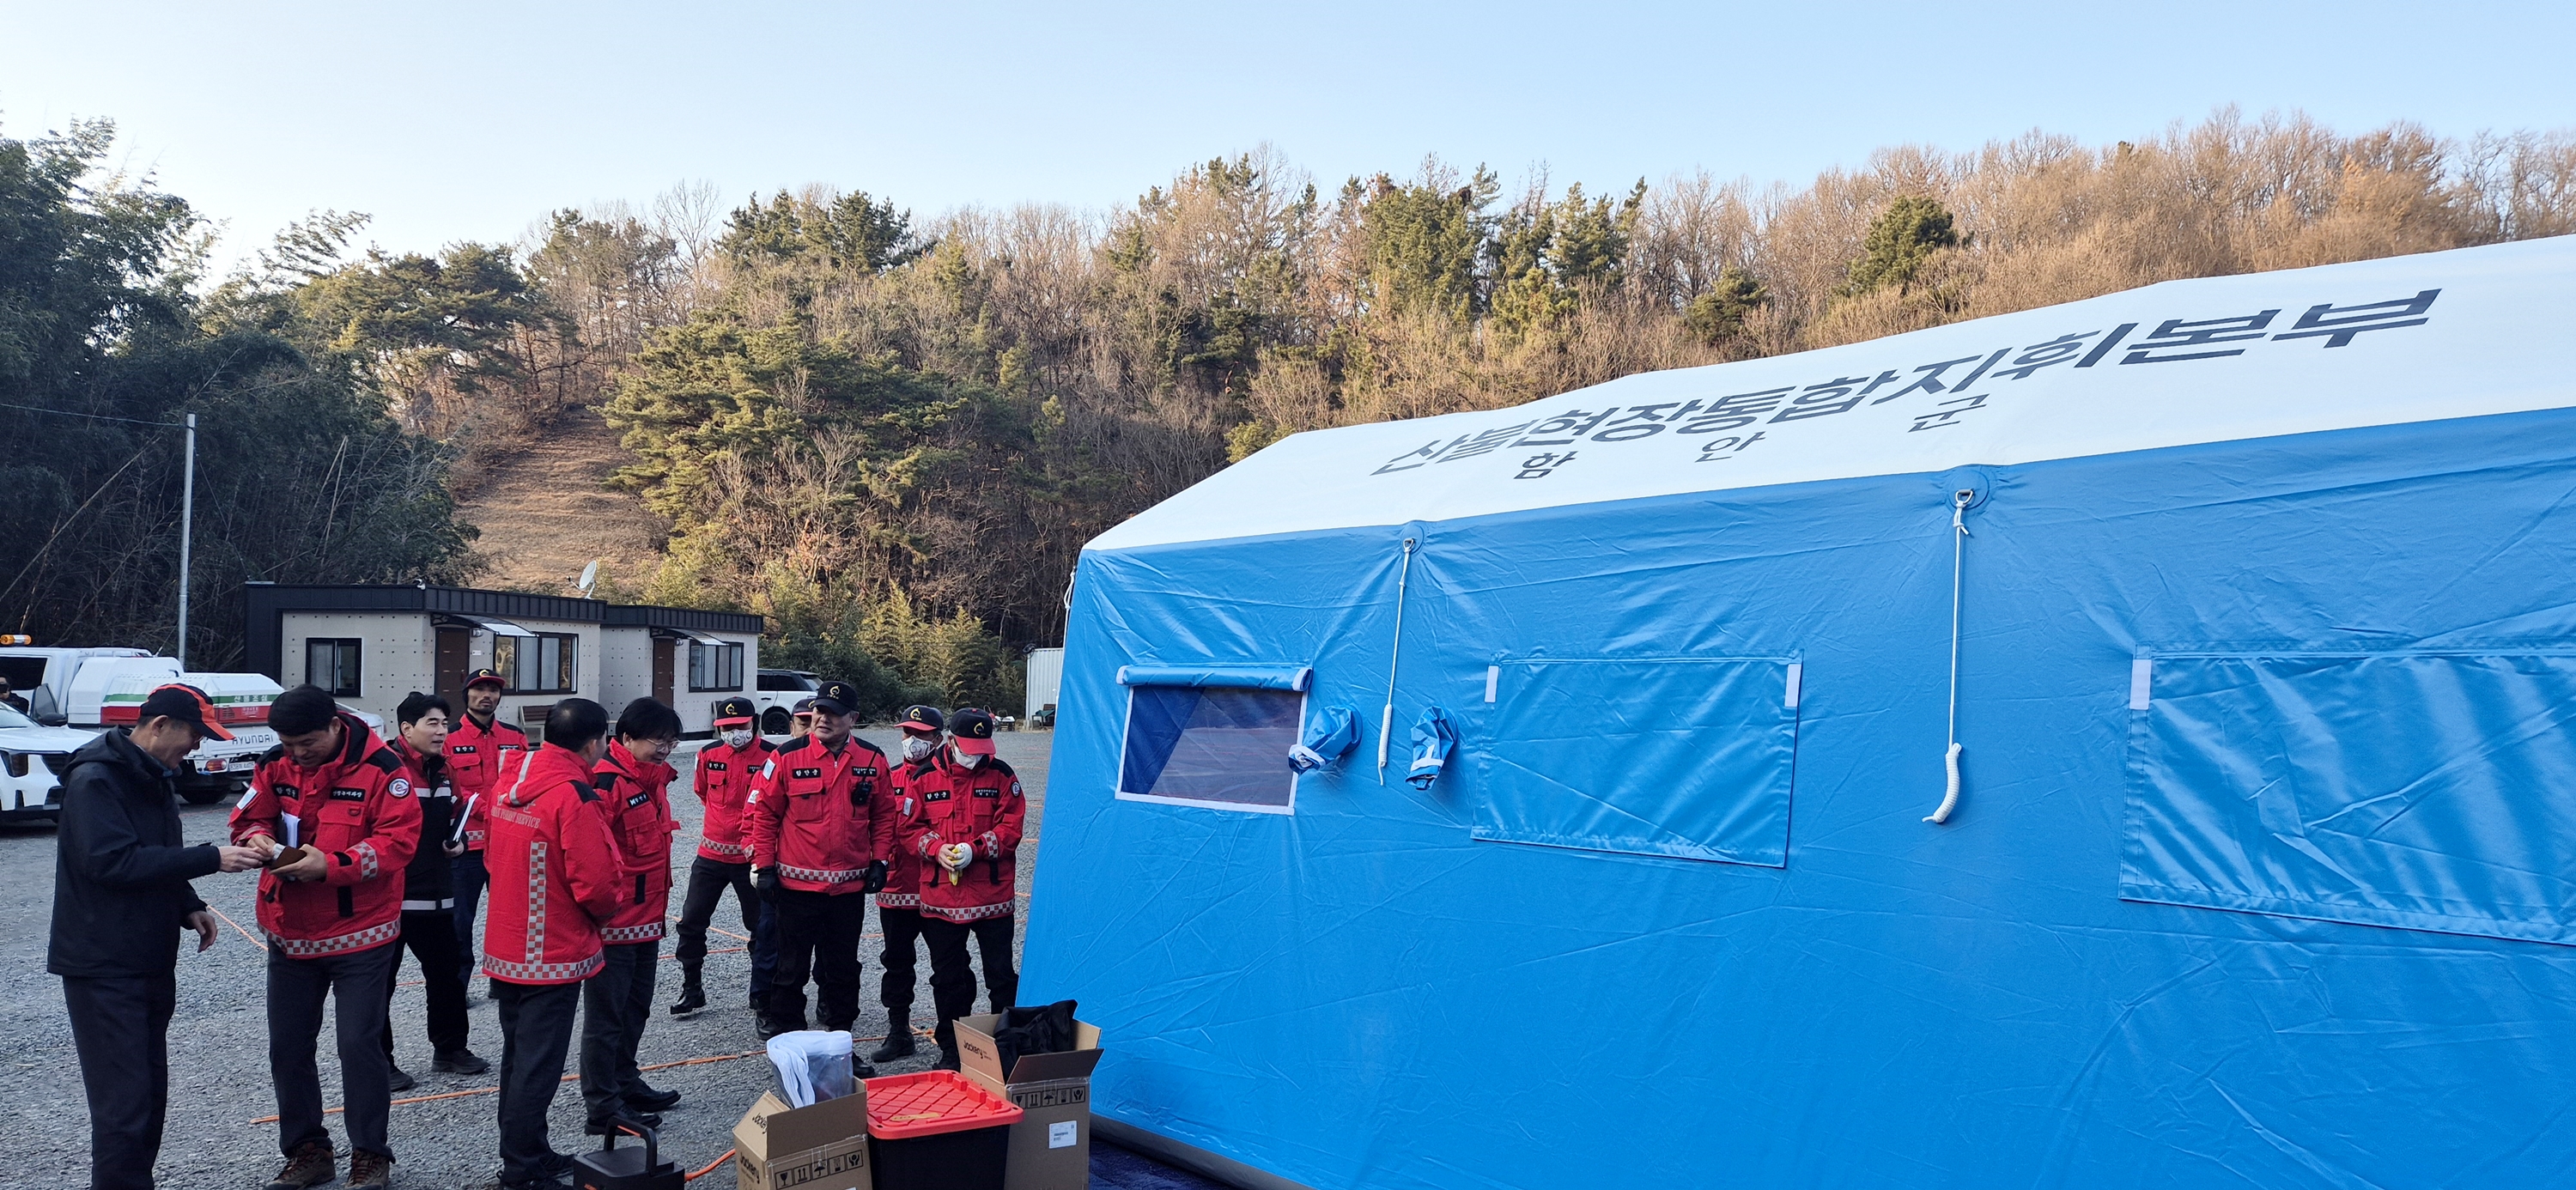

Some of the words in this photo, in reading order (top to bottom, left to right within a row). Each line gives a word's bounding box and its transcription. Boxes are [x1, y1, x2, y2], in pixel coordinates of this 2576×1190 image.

[1370, 288, 2442, 477] 산불현장통합지휘본부
[232, 734, 274, 745] HYUNDAI
[515, 812, 541, 829] SERVICE
